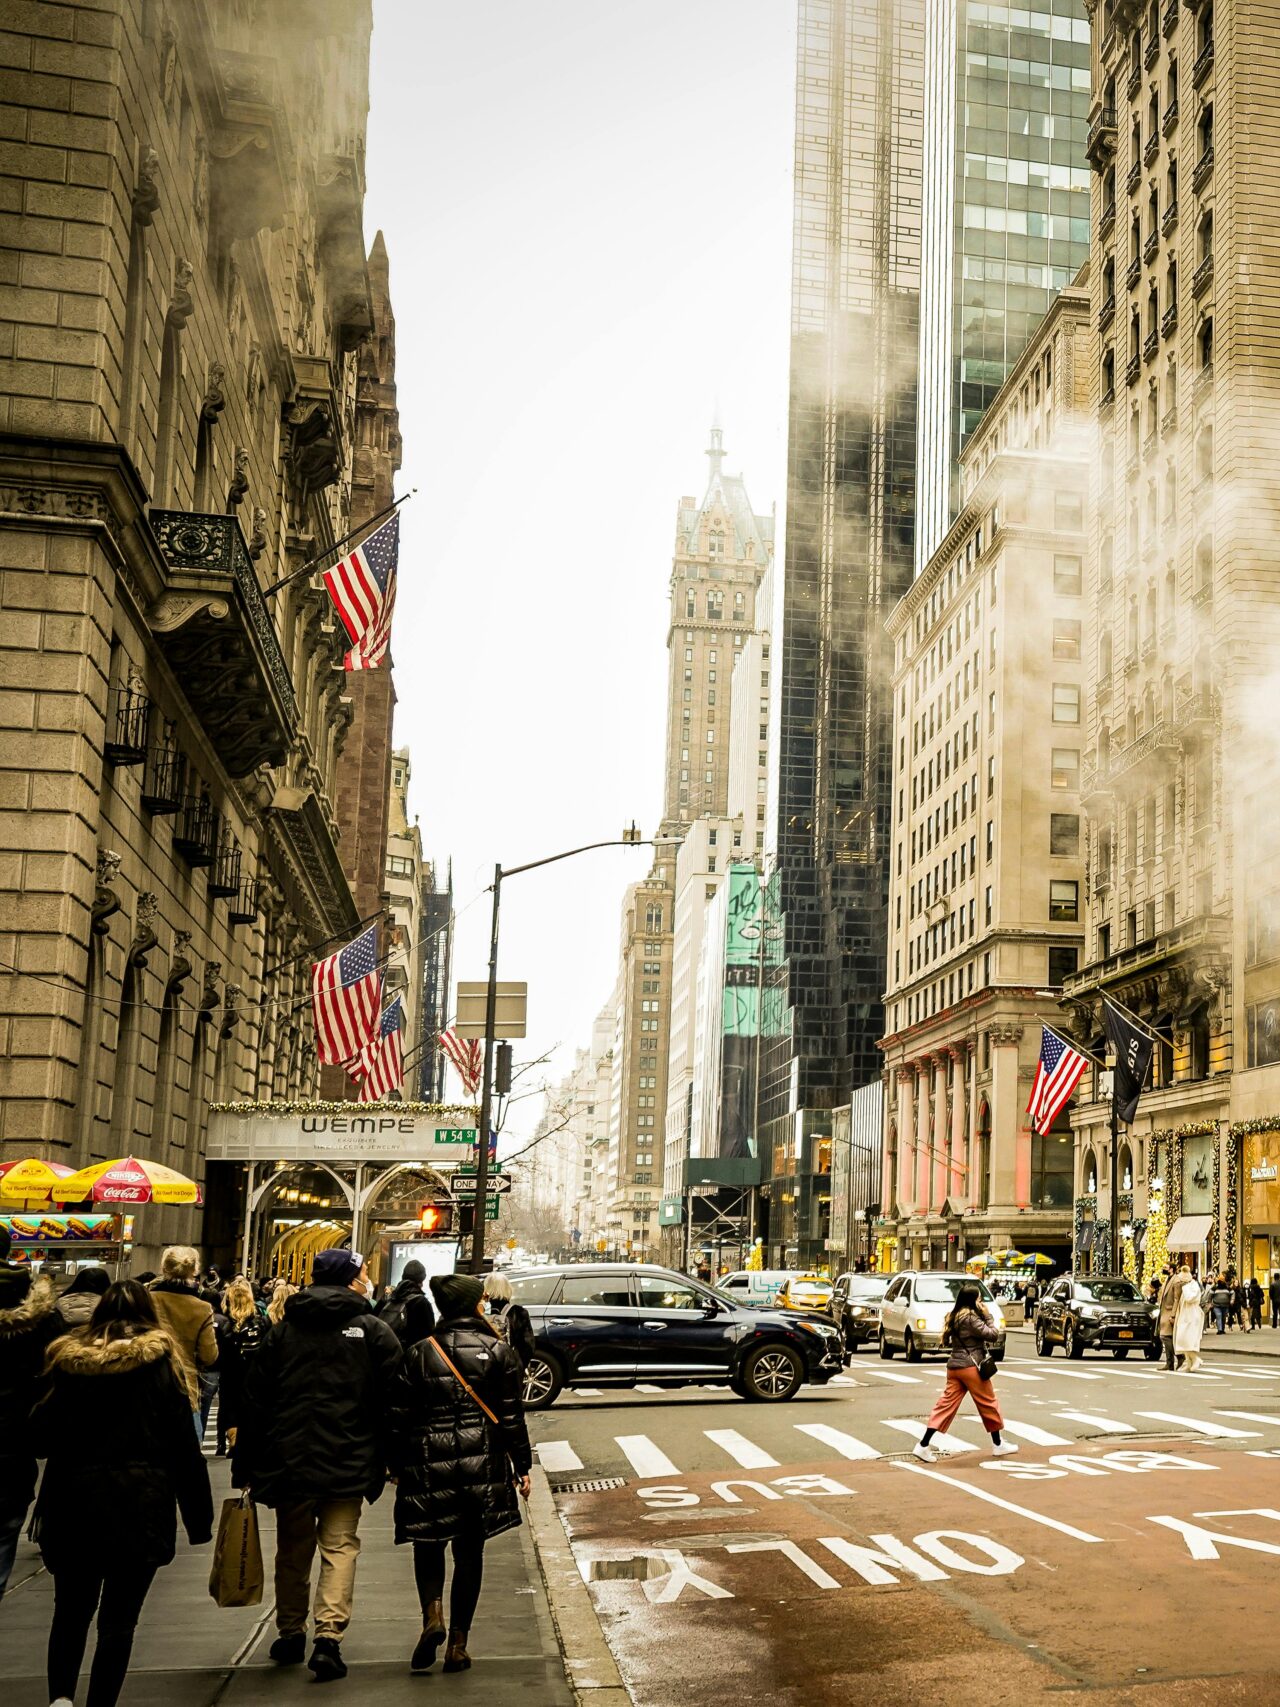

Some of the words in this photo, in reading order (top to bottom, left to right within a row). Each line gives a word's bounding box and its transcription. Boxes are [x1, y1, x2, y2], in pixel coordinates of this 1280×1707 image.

[301, 1117, 415, 1134] WEMPE
[439, 1131, 447, 1142] W
[451, 1130, 463, 1142] 54
[466, 1130, 473, 1138] St
[456, 1180, 474, 1188] ONE
[978, 1449, 1221, 1480] BUS
[637, 1473, 858, 1508] BUS
[643, 1530, 1026, 1602] ONLY
